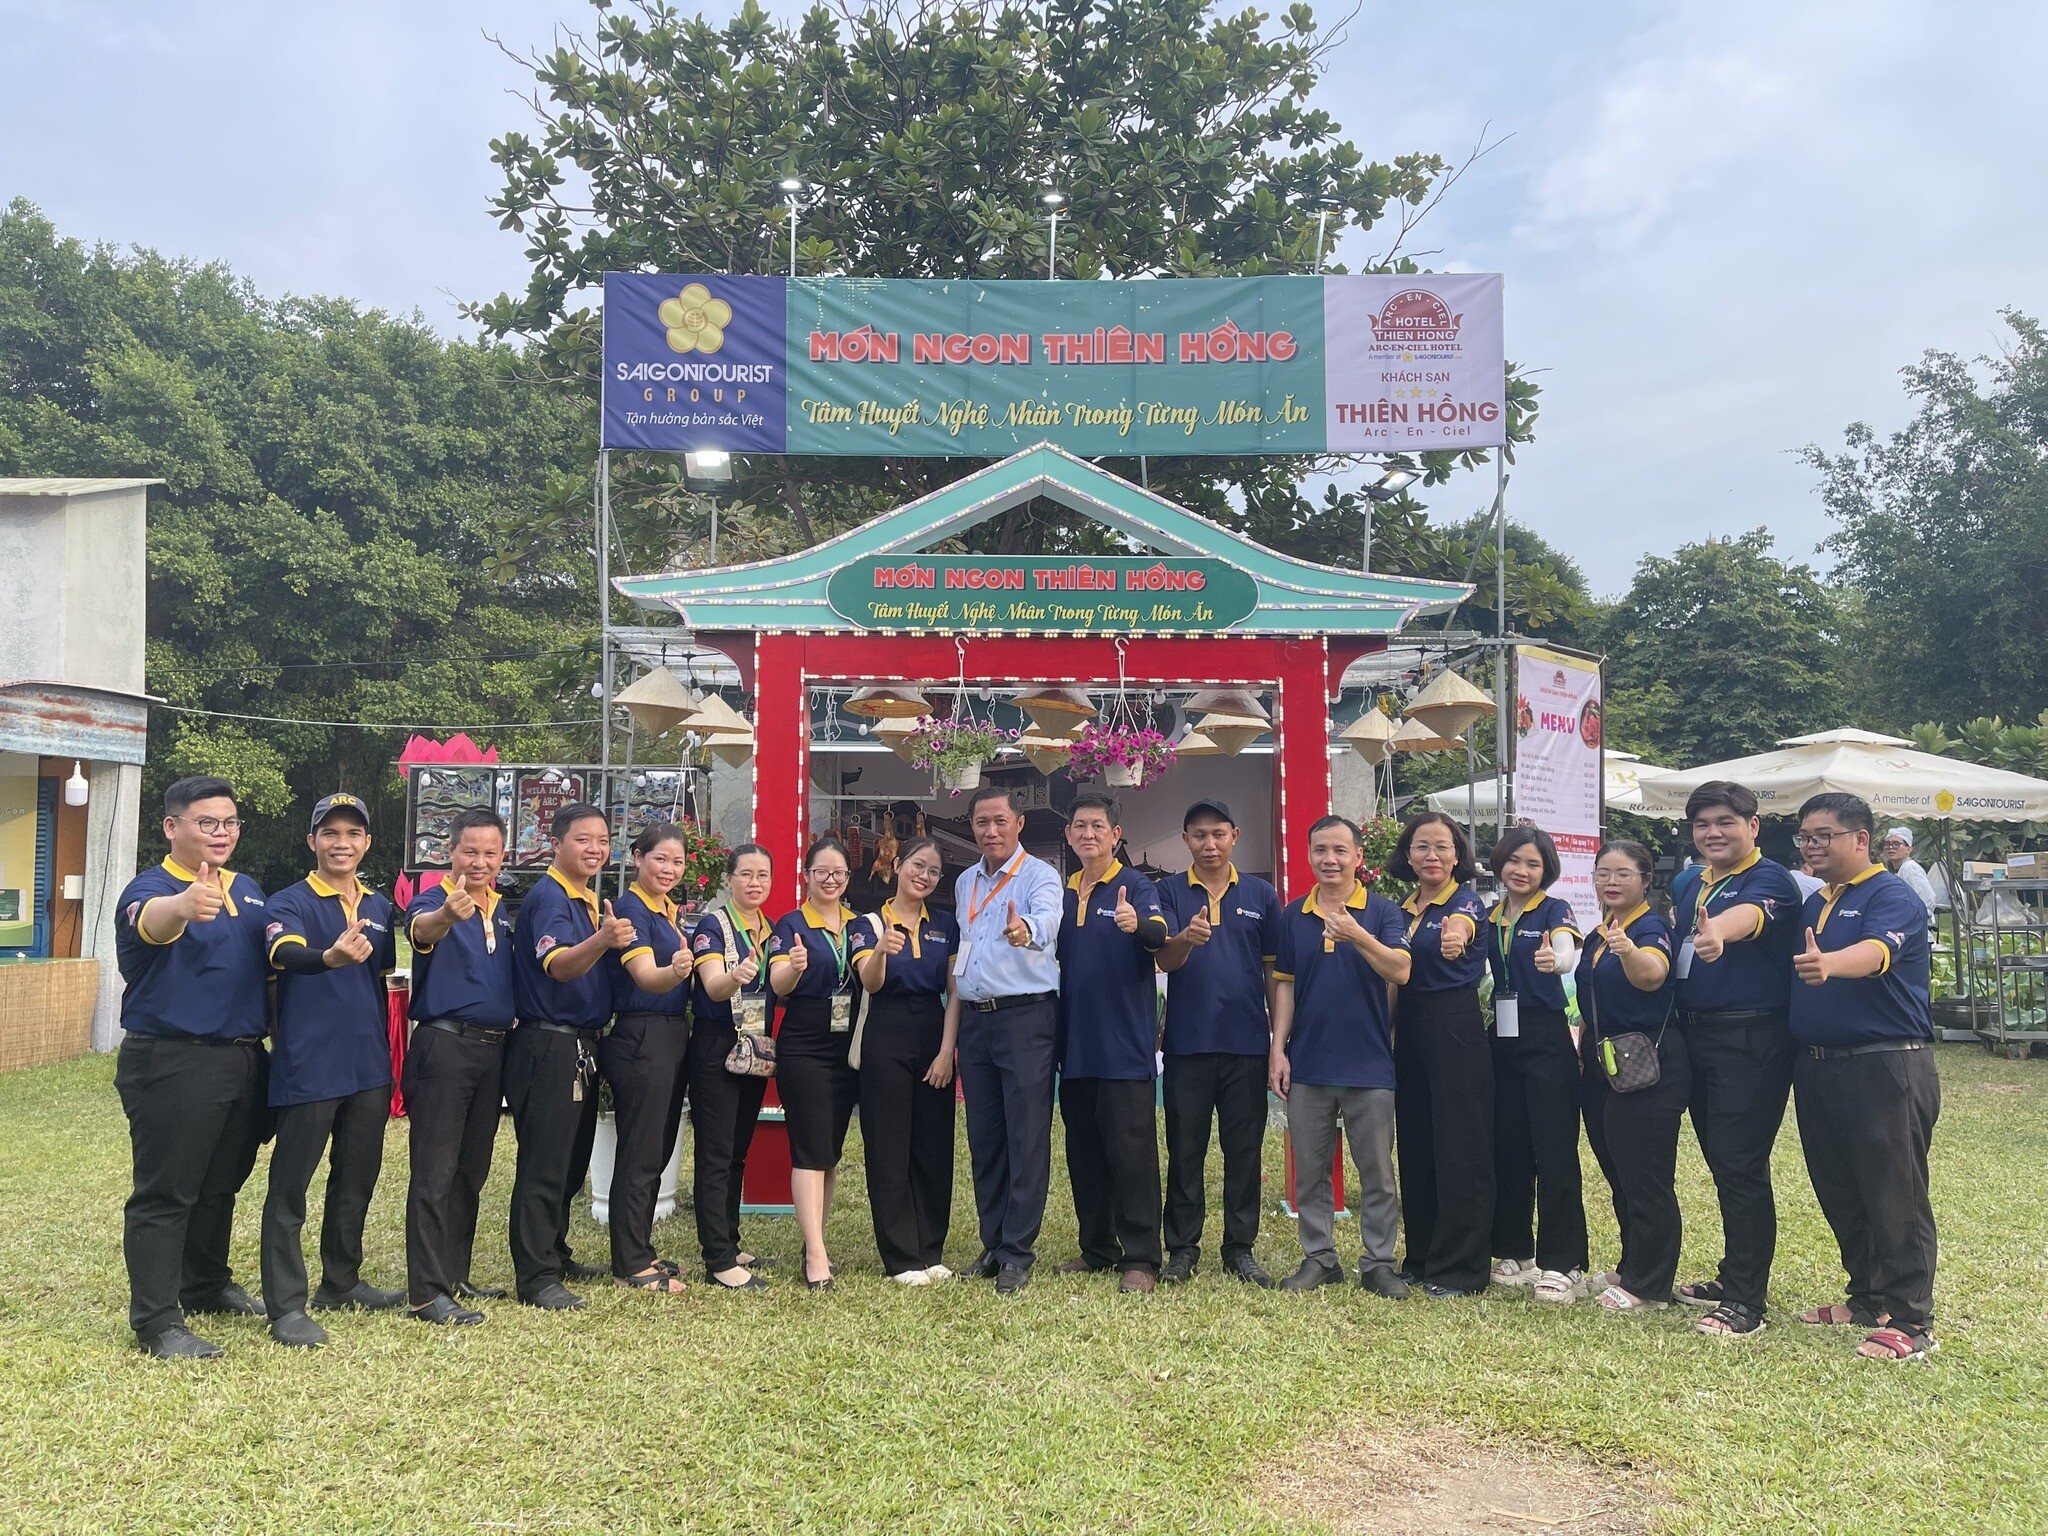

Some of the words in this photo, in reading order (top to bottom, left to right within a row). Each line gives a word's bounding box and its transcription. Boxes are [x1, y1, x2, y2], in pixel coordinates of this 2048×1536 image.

[1384, 303, 1398, 326] ARC
[1406, 293, 1422, 301] EN
[1432, 302, 1447, 326] CIEL
[1395, 317, 1436, 327] HOTEL
[809, 324, 899, 363] MÓN
[913, 333, 1030, 364] NGON
[1179, 320, 1297, 362] HỒNG
[1376, 331, 1414, 340] THIEN
[1417, 331, 1455, 340] HONG
[616, 362, 773, 383] SAIGONTOURIST
[1381, 370, 1423, 383] KHÁCH
[1425, 372, 1450, 384] SẠN
[643, 388, 746, 403] GROUP
[801, 399, 853, 424] Tâm
[857, 399, 920, 437] Huyết
[923, 399, 989, 437] Nghệ
[991, 399, 1062, 428] Nhân
[1064, 402, 1134, 436] Trong
[1138, 401, 1199, 436] Từng
[1203, 399, 1262, 426] Món
[1265, 393, 1310, 425] Ăn
[1336, 398, 1408, 424] THIÊN
[1418, 392, 1499, 423] HỒNG
[625, 412, 647, 427] Tận
[650, 411, 689, 428] hưởng
[692, 413, 715, 426] bản
[718, 413, 738, 426] sắc
[741, 413, 764, 428] Việt
[1364, 428, 1387, 437] Arc
[1407, 427, 1423, 436] En
[1443, 426, 1471, 436] Ciel
[874, 562, 935, 588] MÓN
[945, 568, 1025, 590] NGON
[1126, 561, 1206, 591] HỒNG
[867, 602, 903, 619] Tâm
[905, 601, 950, 627] Huyết
[951, 601, 997, 627] Nghệ
[998, 601, 1046, 621] Nhân
[1048, 604, 1095, 628] Trong
[1097, 604, 1139, 628] Từng
[1142, 604, 1182, 621] Món
[1184, 601, 1214, 621] Ăn
[1540, 712, 1576, 735] MENU
[330, 796, 357, 806] ARC
[541, 797, 558, 806] ARC
[1873, 793, 1881, 803] A
[1882, 794, 1920, 804] member
[1921, 795, 1930, 805] of
[1957, 796, 2026, 810] SAIGONTOURIST
